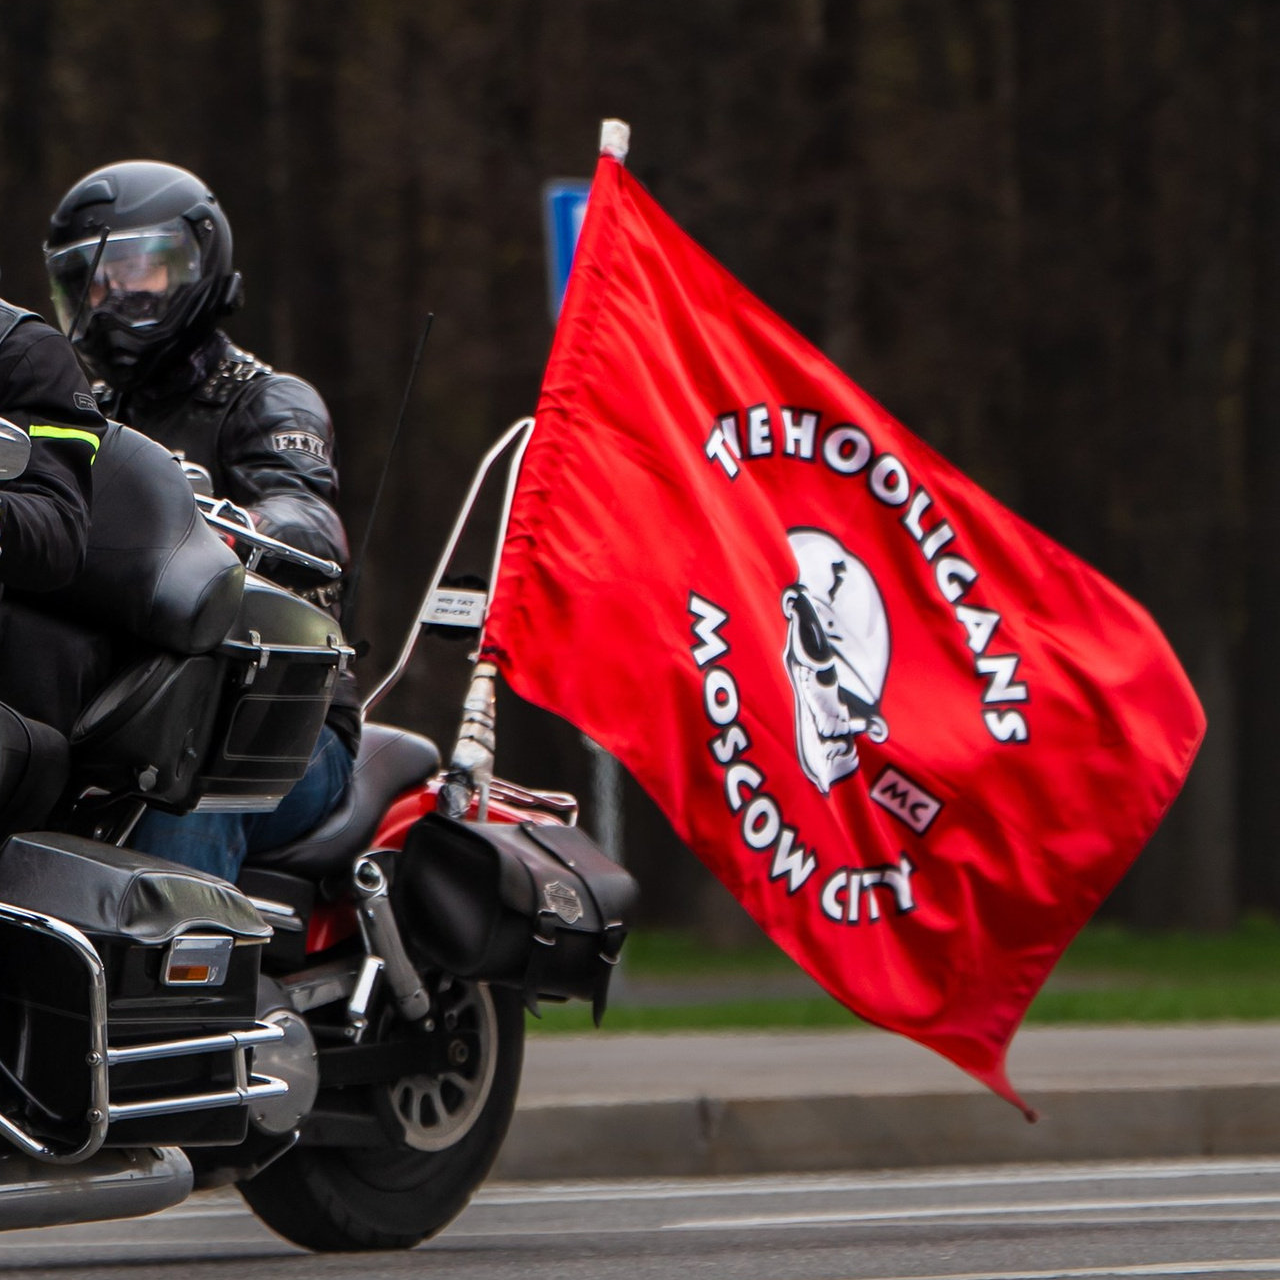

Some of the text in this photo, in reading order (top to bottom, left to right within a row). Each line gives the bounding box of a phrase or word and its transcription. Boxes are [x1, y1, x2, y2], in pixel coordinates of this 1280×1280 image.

[780, 404, 1029, 743] HOOLIGANS
[689, 591, 917, 924] MOSCOW CITY
[880, 781, 930, 825] MC
